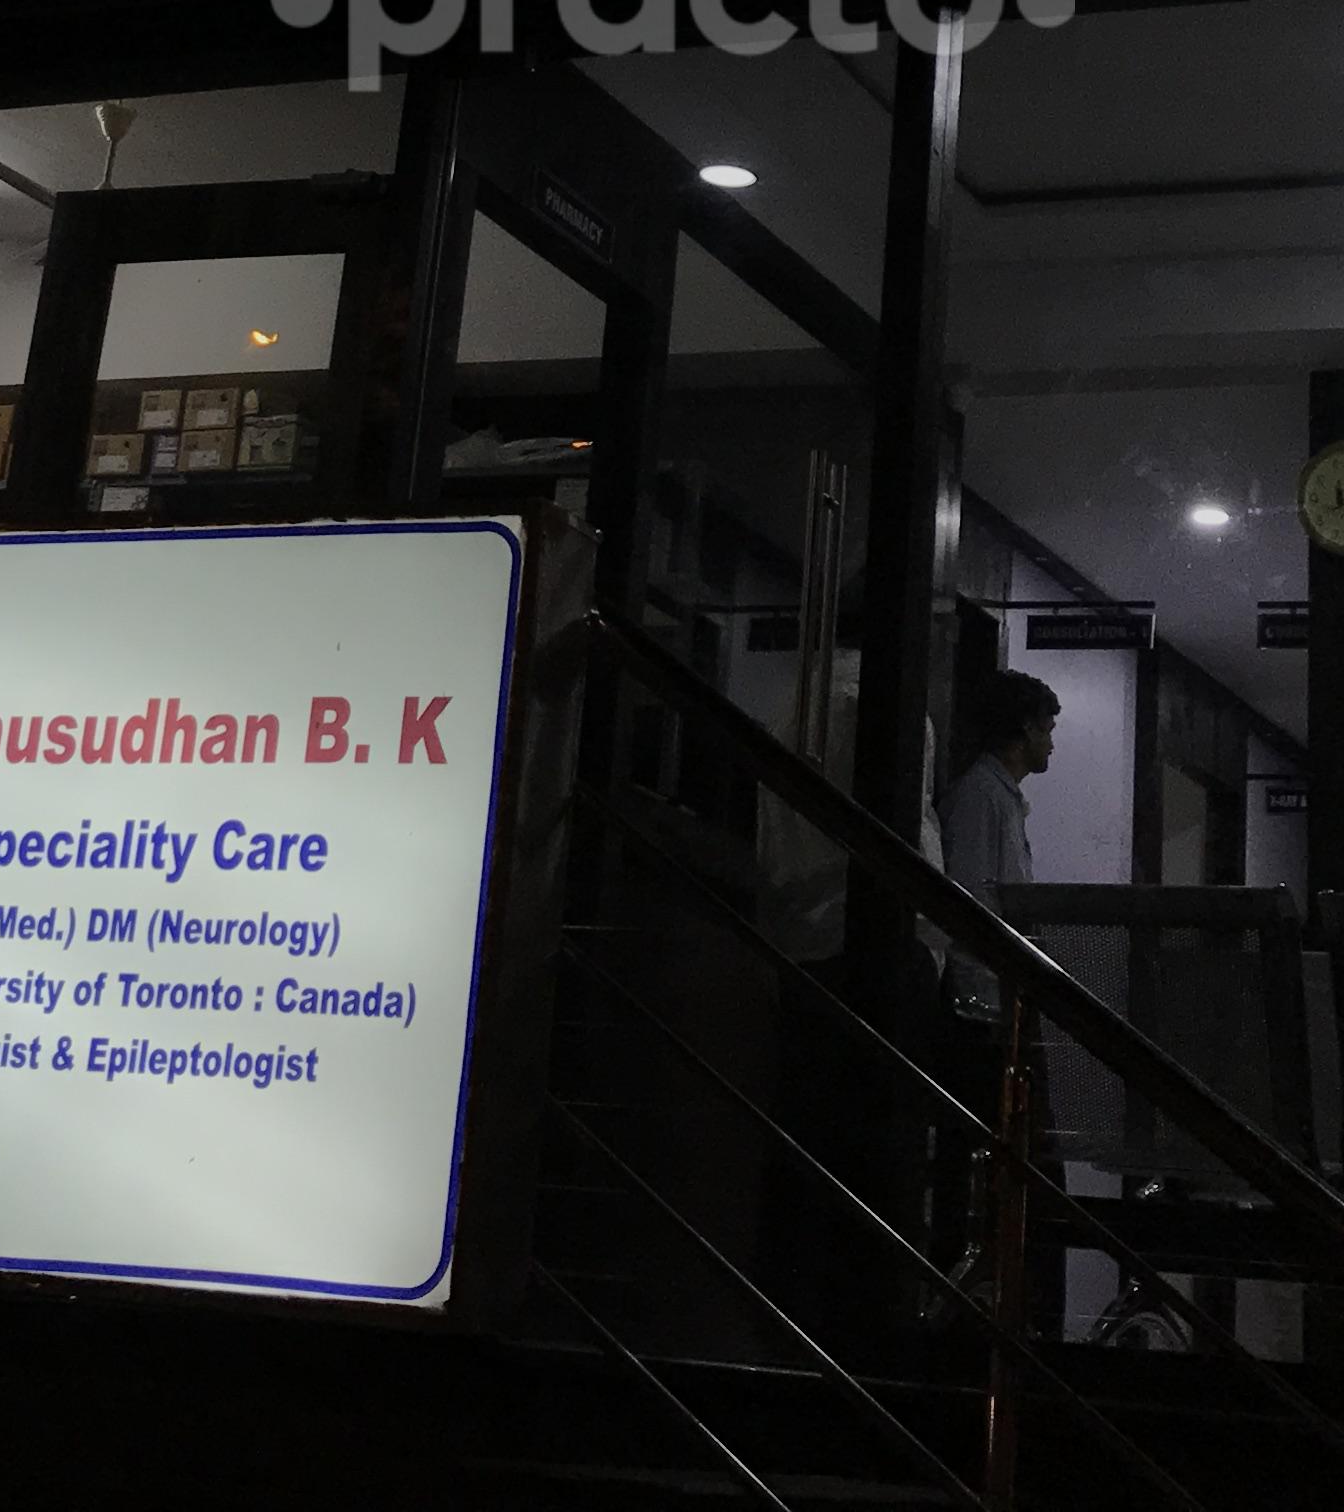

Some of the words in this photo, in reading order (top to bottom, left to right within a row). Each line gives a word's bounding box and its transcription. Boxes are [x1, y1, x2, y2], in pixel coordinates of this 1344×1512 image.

[544, 186, 605, 246] PHARMACY
[304, 697, 369, 762] B.
[399, 698, 448, 764] K
[211, 818, 329, 873] Care
[85, 907, 139, 943] DM
[145, 909, 341, 957] (Neurology)
[72, 971, 108, 1007] of
[117, 971, 245, 1012] Toronto
[273, 976, 417, 1024] Canada)
[50, 1035, 74, 1072] &
[86, 1036, 318, 1090] Epileptologist
